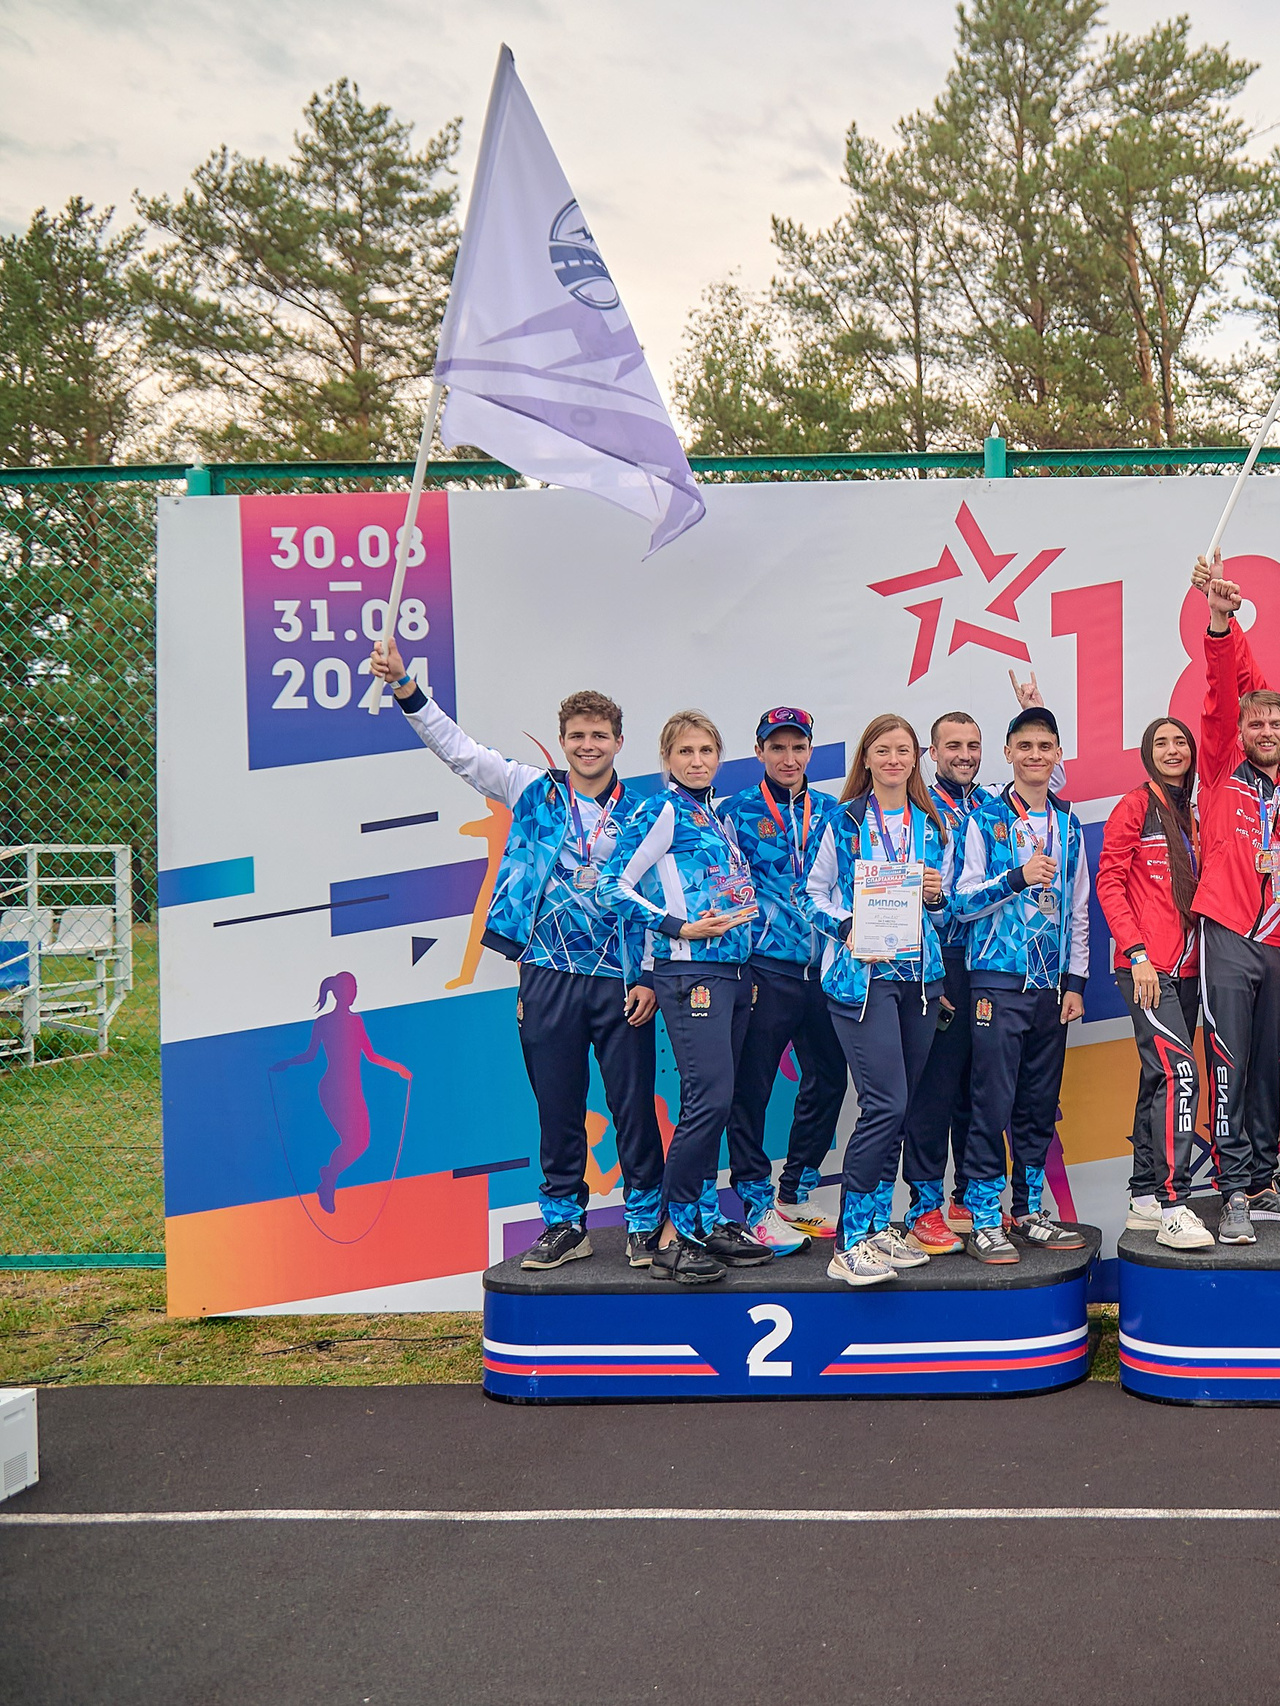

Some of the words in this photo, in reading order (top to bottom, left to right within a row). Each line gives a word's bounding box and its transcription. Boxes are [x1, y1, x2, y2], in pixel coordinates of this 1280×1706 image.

[270, 524, 427, 570] 30.08
[272, 597, 430, 643] 31.08
[271, 656, 433, 710] 2024
[864, 865, 878, 878] 18
[740, 885, 756, 906] 2
[867, 898, 908, 908] ДИПЛОМ
[1176, 1060, 1194, 1133] БРИЗ
[1215, 1065, 1230, 1137] БРИЗ
[746, 1304, 793, 1376] 2
